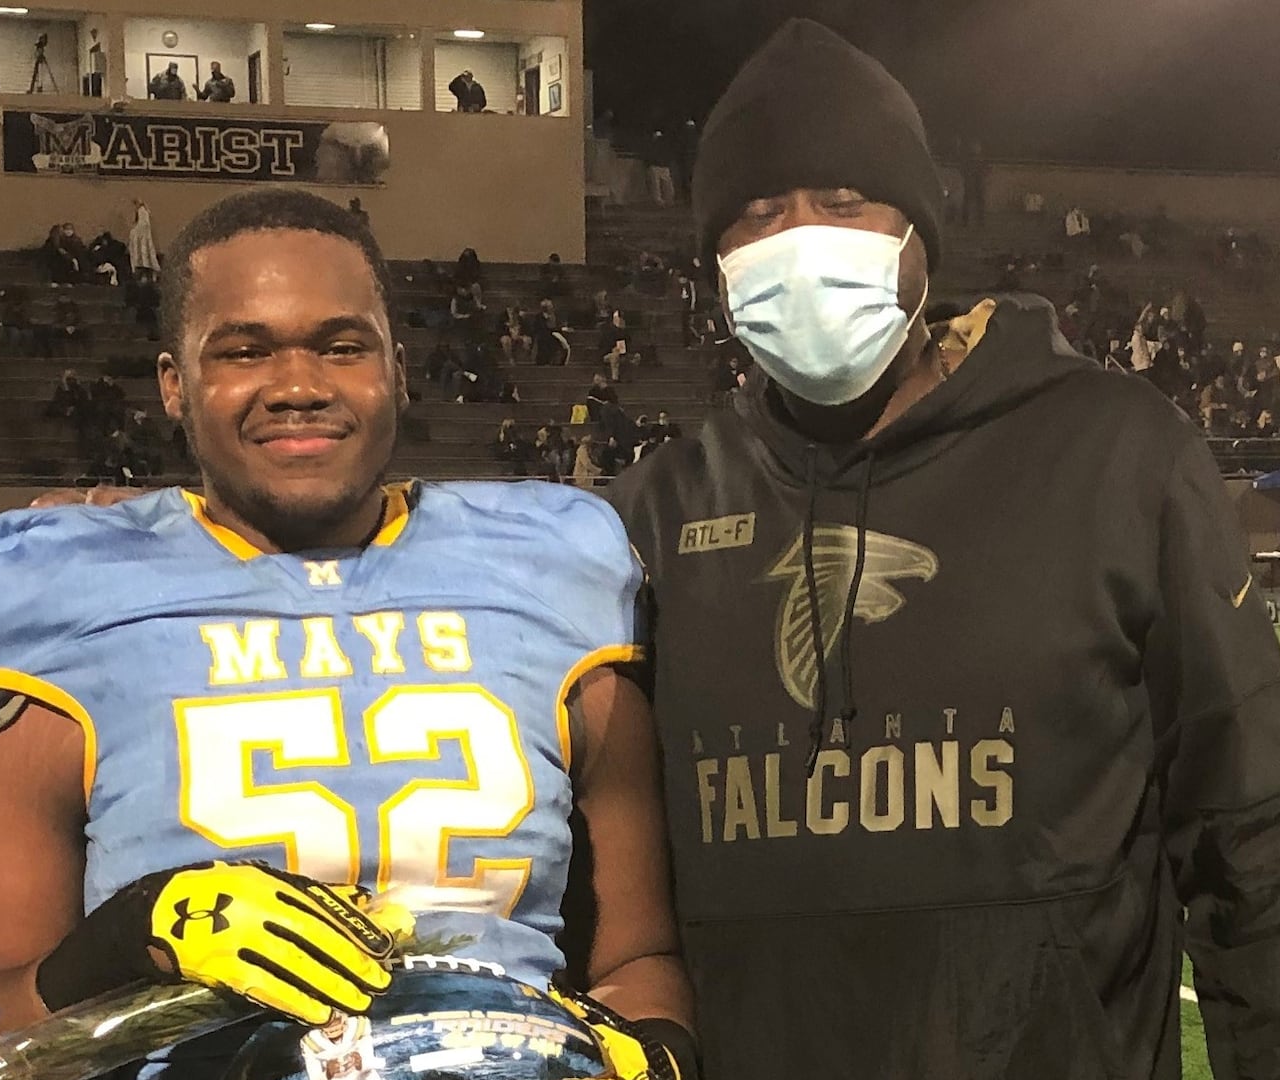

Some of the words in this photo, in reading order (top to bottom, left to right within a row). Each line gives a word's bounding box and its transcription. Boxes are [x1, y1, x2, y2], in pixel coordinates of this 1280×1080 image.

[38, 116, 303, 175] MARIST
[303, 560, 343, 586] M
[198, 611, 474, 686] MAYS
[691, 707, 1015, 754] ATLANTA
[172, 683, 535, 922] 52
[696, 739, 1015, 843] FALCONS
